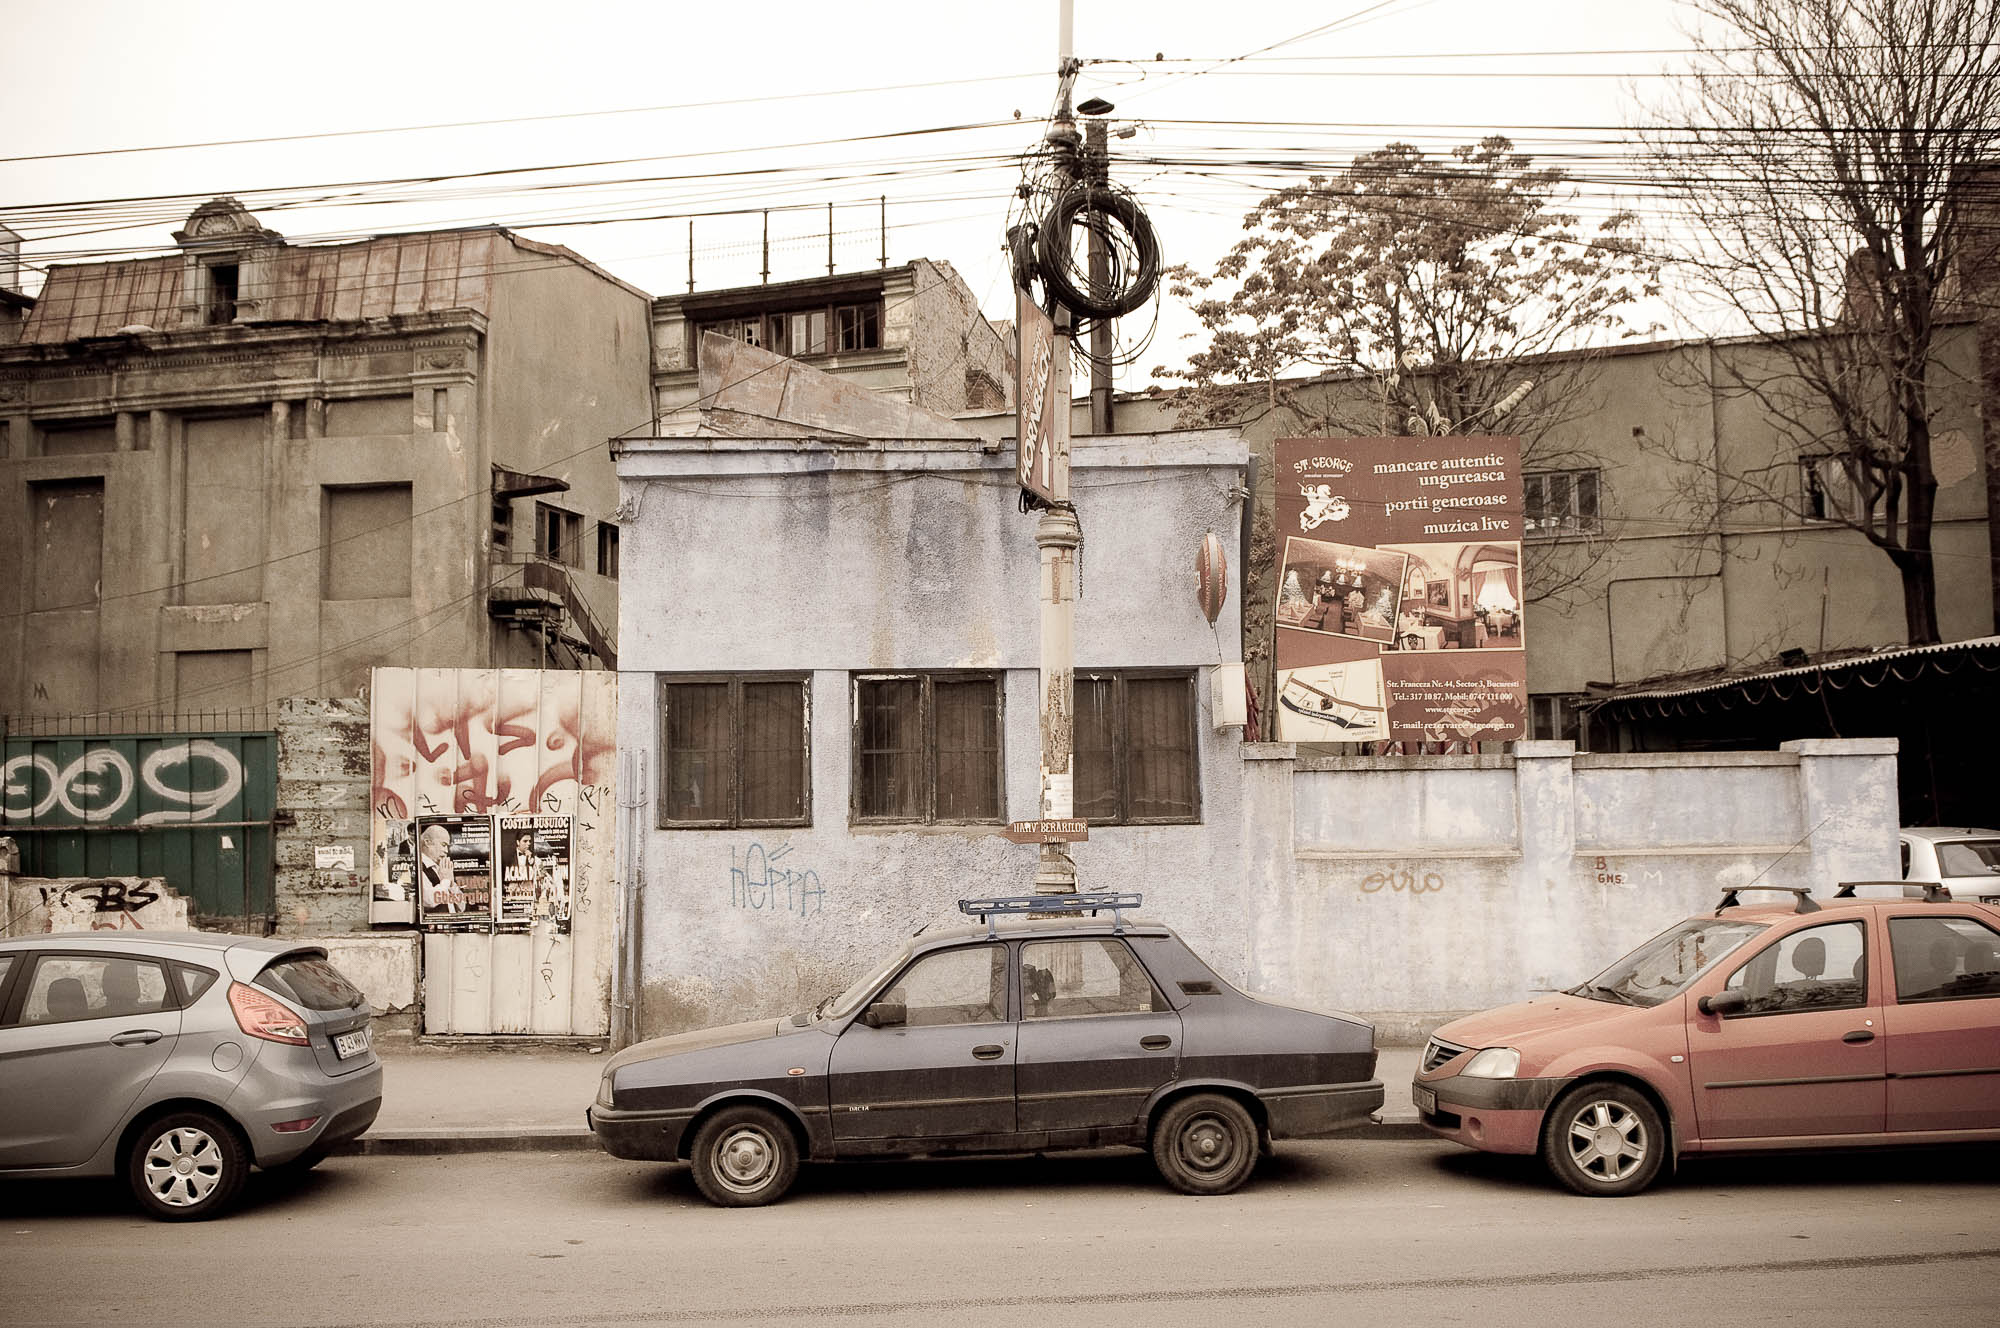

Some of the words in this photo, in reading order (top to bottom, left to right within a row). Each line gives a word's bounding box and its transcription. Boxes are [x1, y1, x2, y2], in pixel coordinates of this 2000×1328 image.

[1021, 336, 1051, 485] HORNBACH
[1293, 459, 1311, 473] ST.
[1311, 456, 1353, 473] GEORGE
[1373, 460, 1438, 474] mancare
[1441, 453, 1504, 470] autentic
[1419, 471, 1505, 489] ungureasca
[1385, 496, 1429, 516] portii
[1432, 494, 1507, 513] generoase
[1424, 520, 1479, 534] muzica
[1481, 516, 1509, 531] live
[1431, 680, 1443, 688] Nr.
[1456, 680, 1478, 688] Sector
[1393, 720, 1423, 729] E-mail:
[502, 818, 532, 830] COSTEL
[533, 817, 569, 829] BUSUIOC
